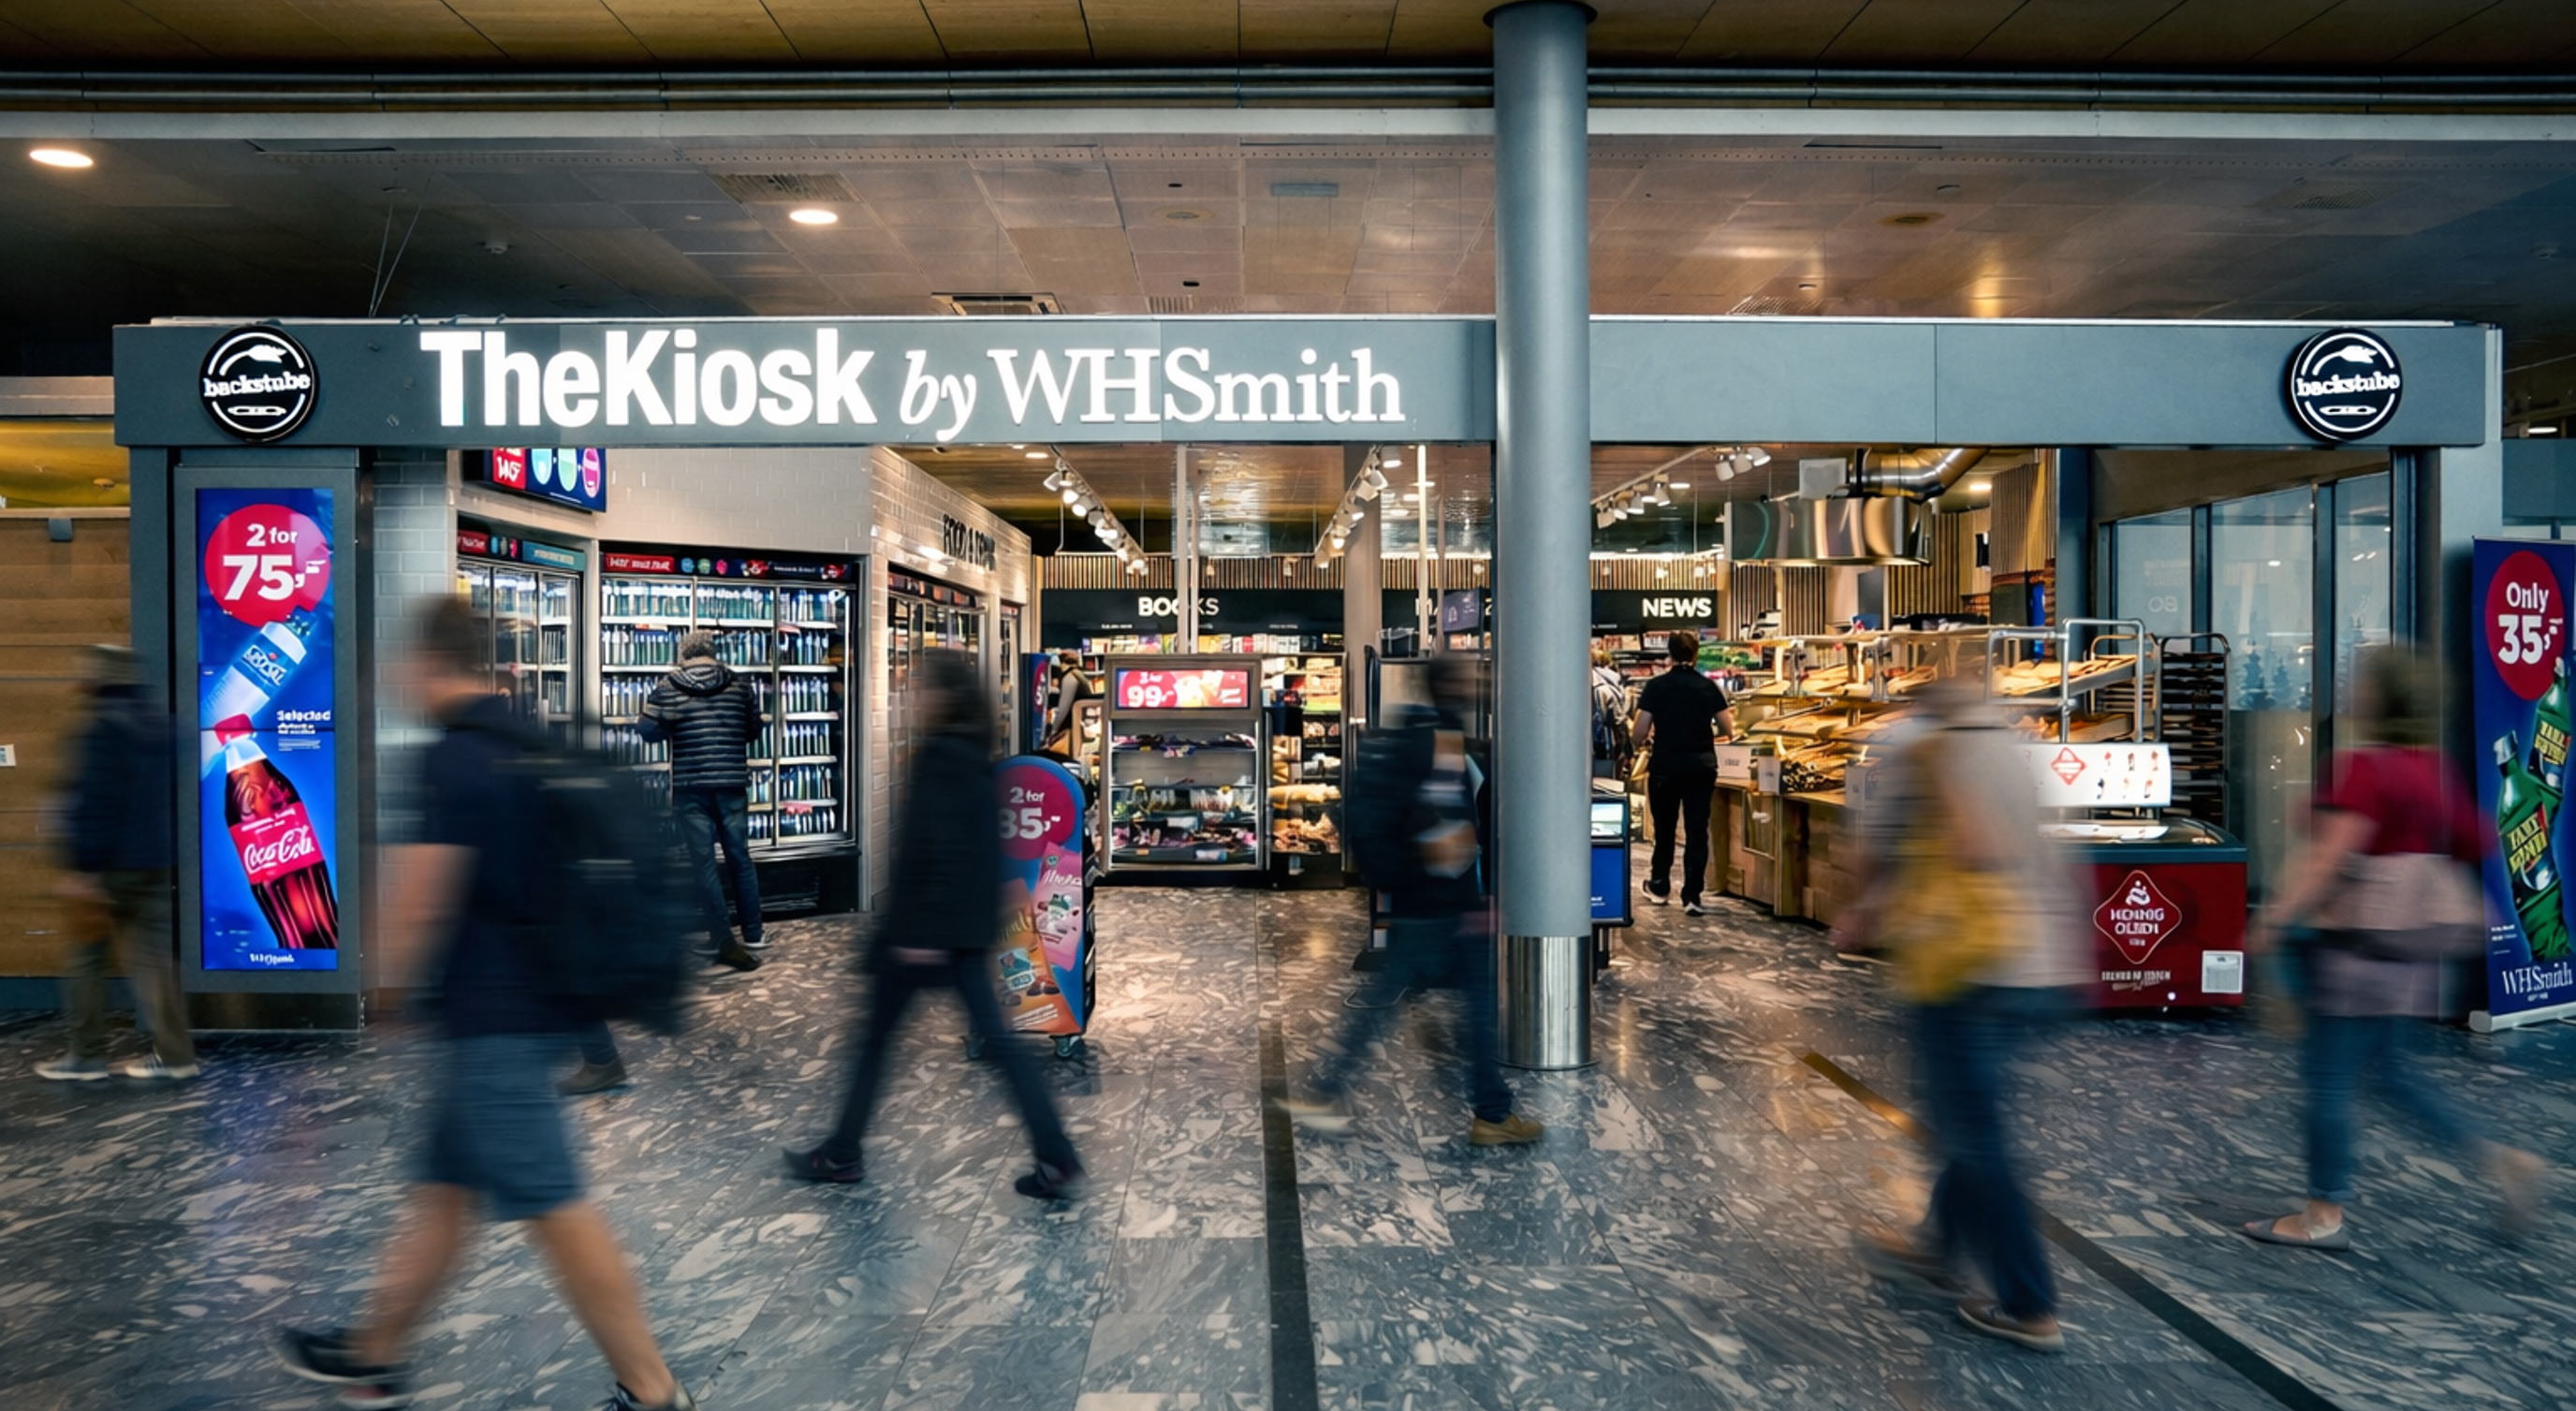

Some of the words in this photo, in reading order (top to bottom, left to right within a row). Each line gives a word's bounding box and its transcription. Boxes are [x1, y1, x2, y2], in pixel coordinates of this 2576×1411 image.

[202, 371, 312, 398] backstube
[419, 328, 878, 428] TheKiosk
[898, 349, 977, 443] by
[986, 346, 1407, 425] WHSmith
[2296, 371, 2401, 397] backstube
[245, 522, 267, 548] 2
[269, 526, 299, 544] for
[1642, 597, 1713, 619] NEWS
[2506, 581, 2550, 615] Only
[1009, 786, 1025, 803] 2
[1026, 789, 1046, 803] for
